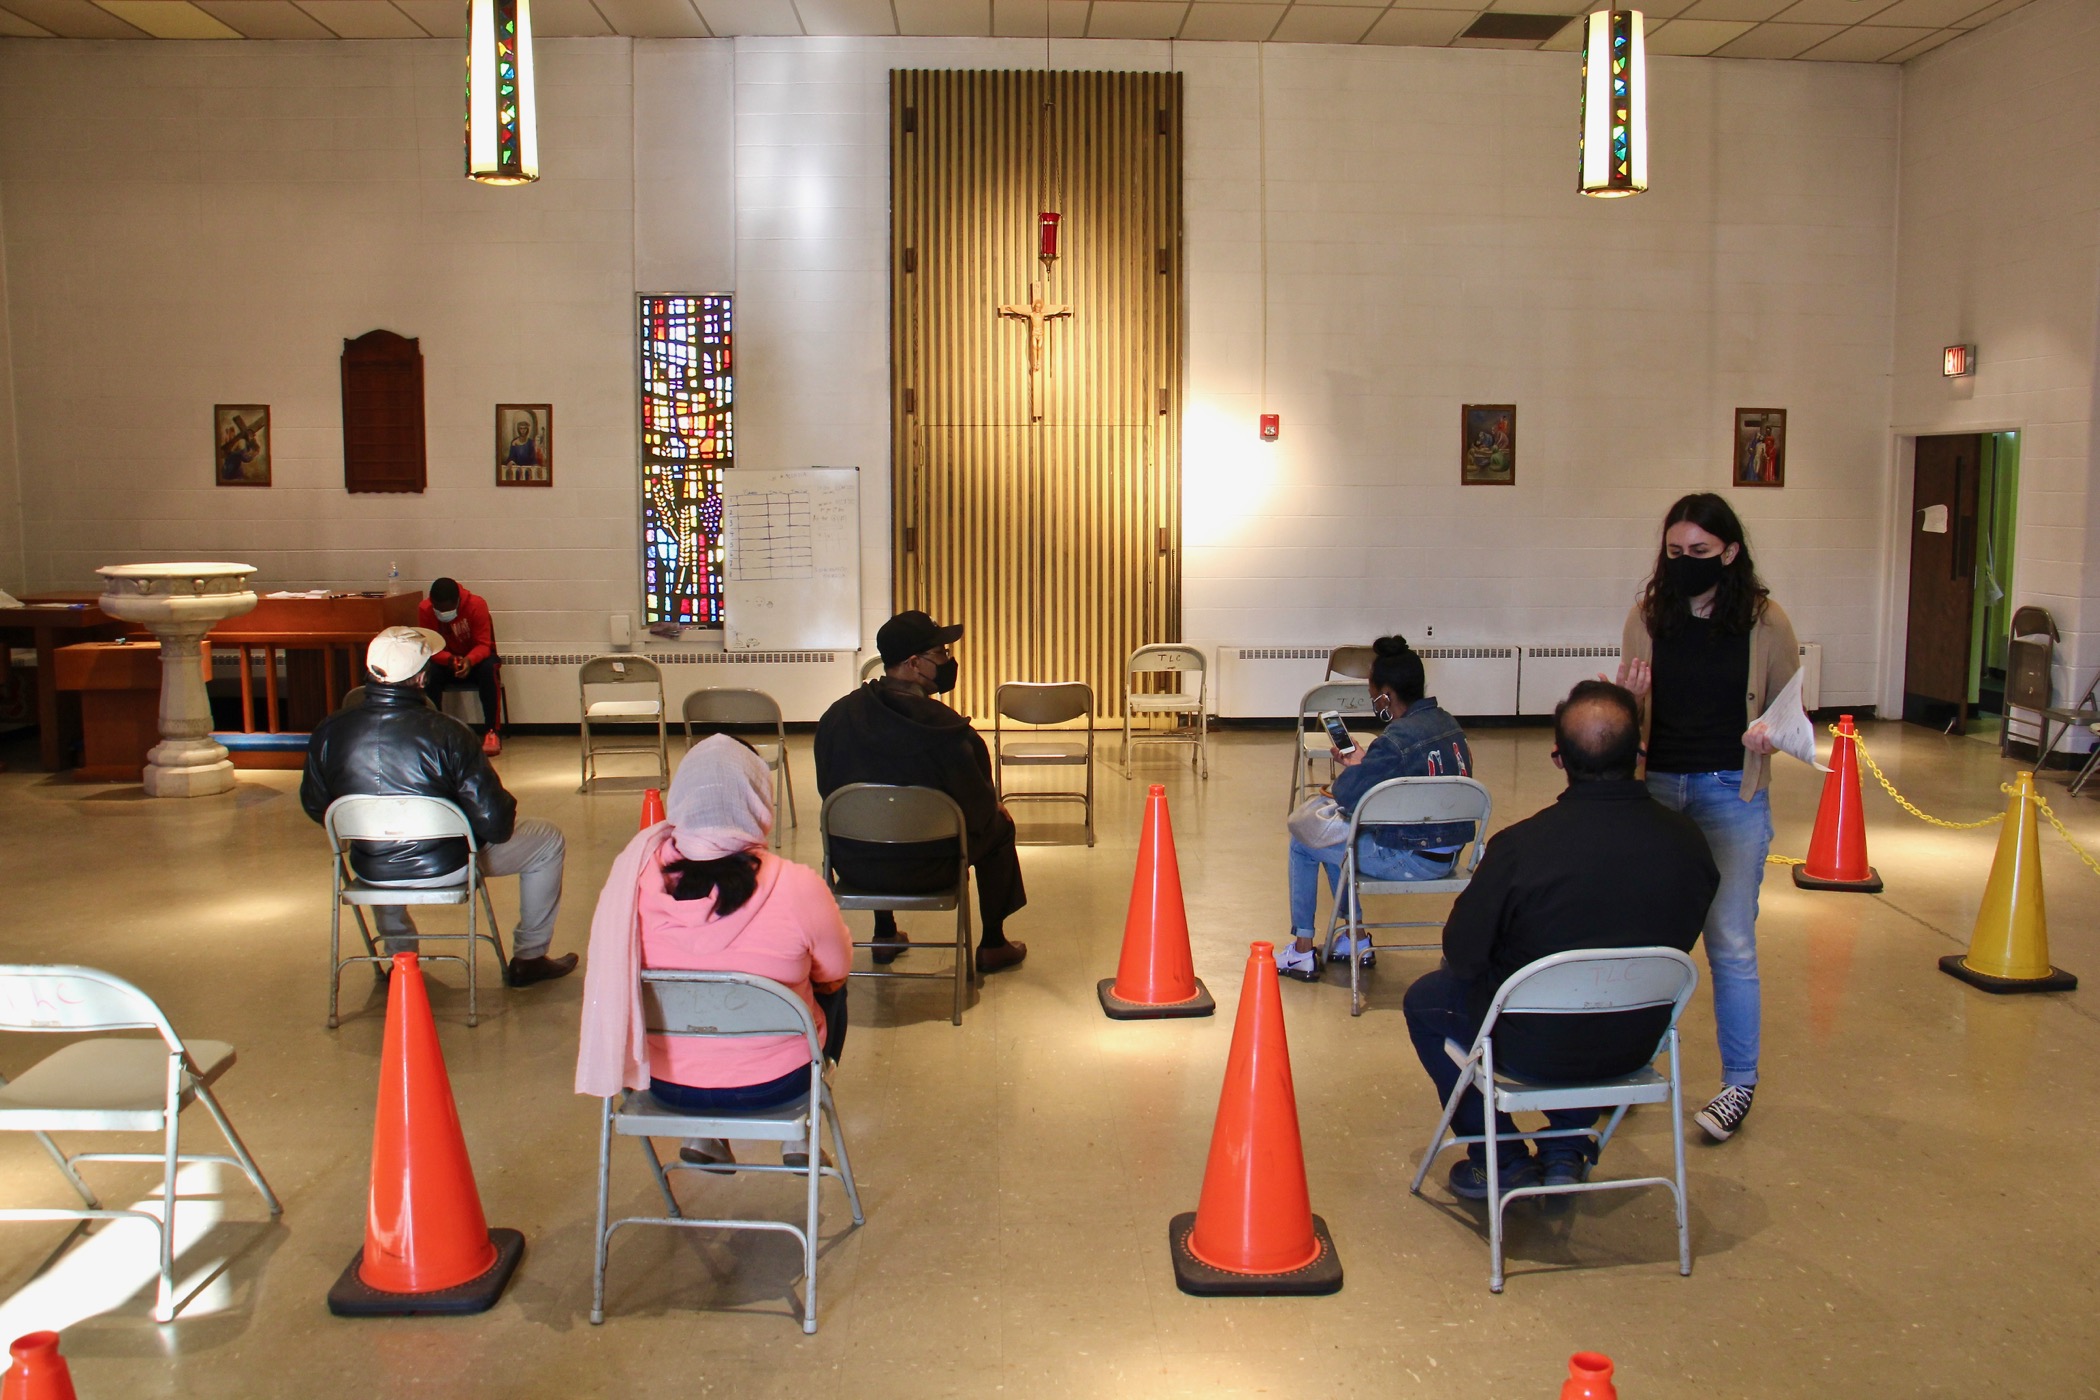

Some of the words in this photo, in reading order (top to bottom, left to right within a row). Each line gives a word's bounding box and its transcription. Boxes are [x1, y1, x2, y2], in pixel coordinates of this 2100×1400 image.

[1946, 347, 1965, 374] EXIT
[1157, 653, 1182, 663] TLC
[1336, 697, 1365, 707] TLC
[1590, 962, 1642, 987] TLC
